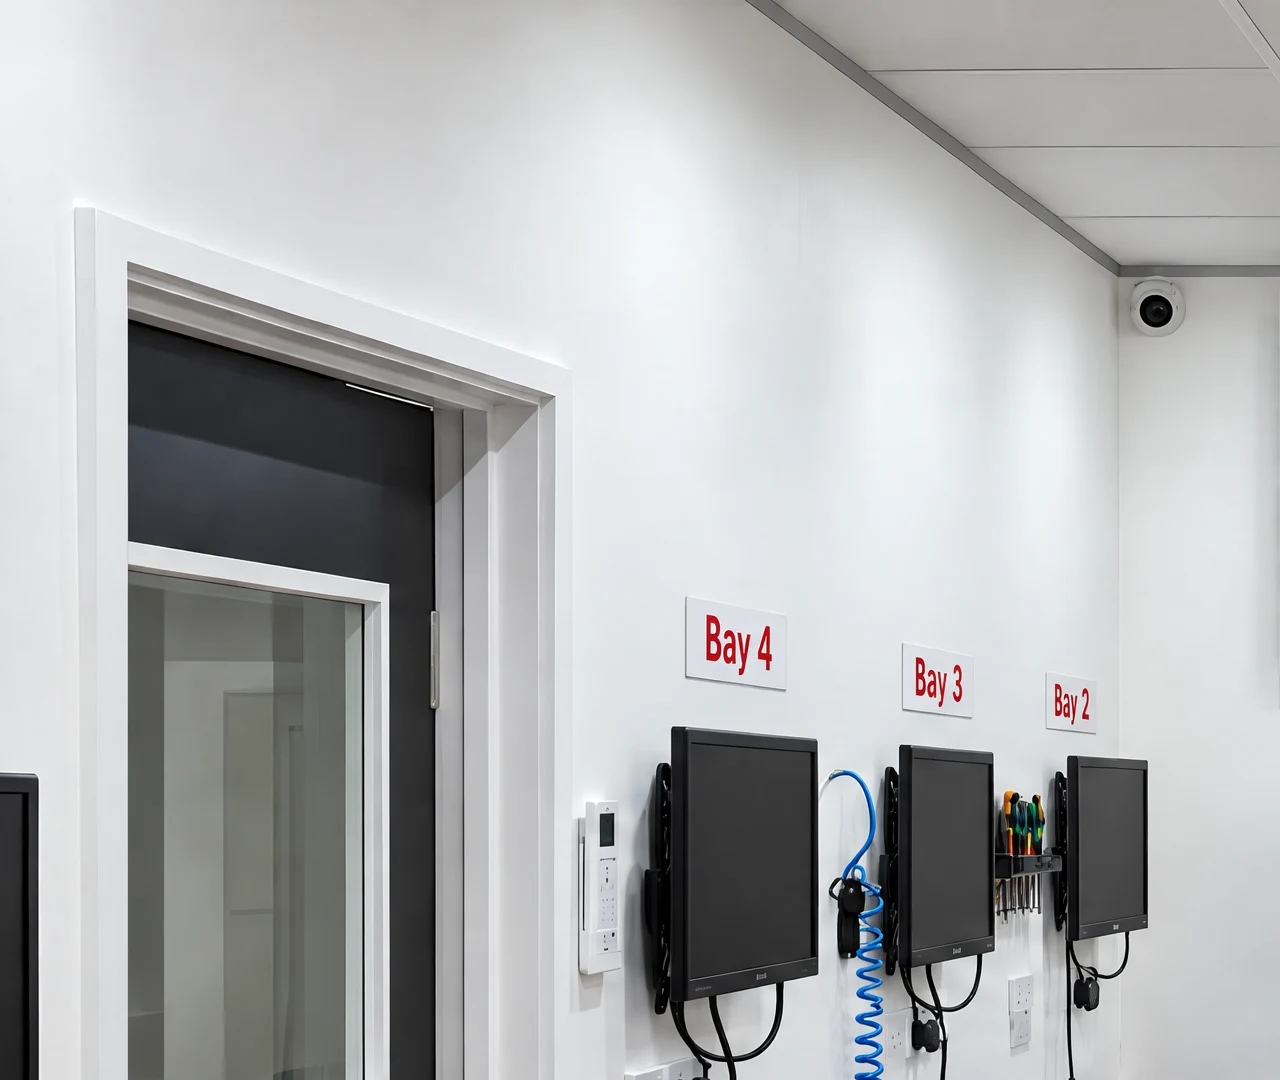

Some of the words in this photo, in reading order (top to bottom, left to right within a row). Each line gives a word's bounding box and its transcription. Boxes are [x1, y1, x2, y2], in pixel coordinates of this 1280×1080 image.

[705, 614, 751, 676] Bay
[757, 625, 773, 671] 4
[915, 656, 948, 708] Bay
[951, 664, 963, 703] 3
[1053, 683, 1079, 725] Bay
[1081, 687, 1090, 721] 2
